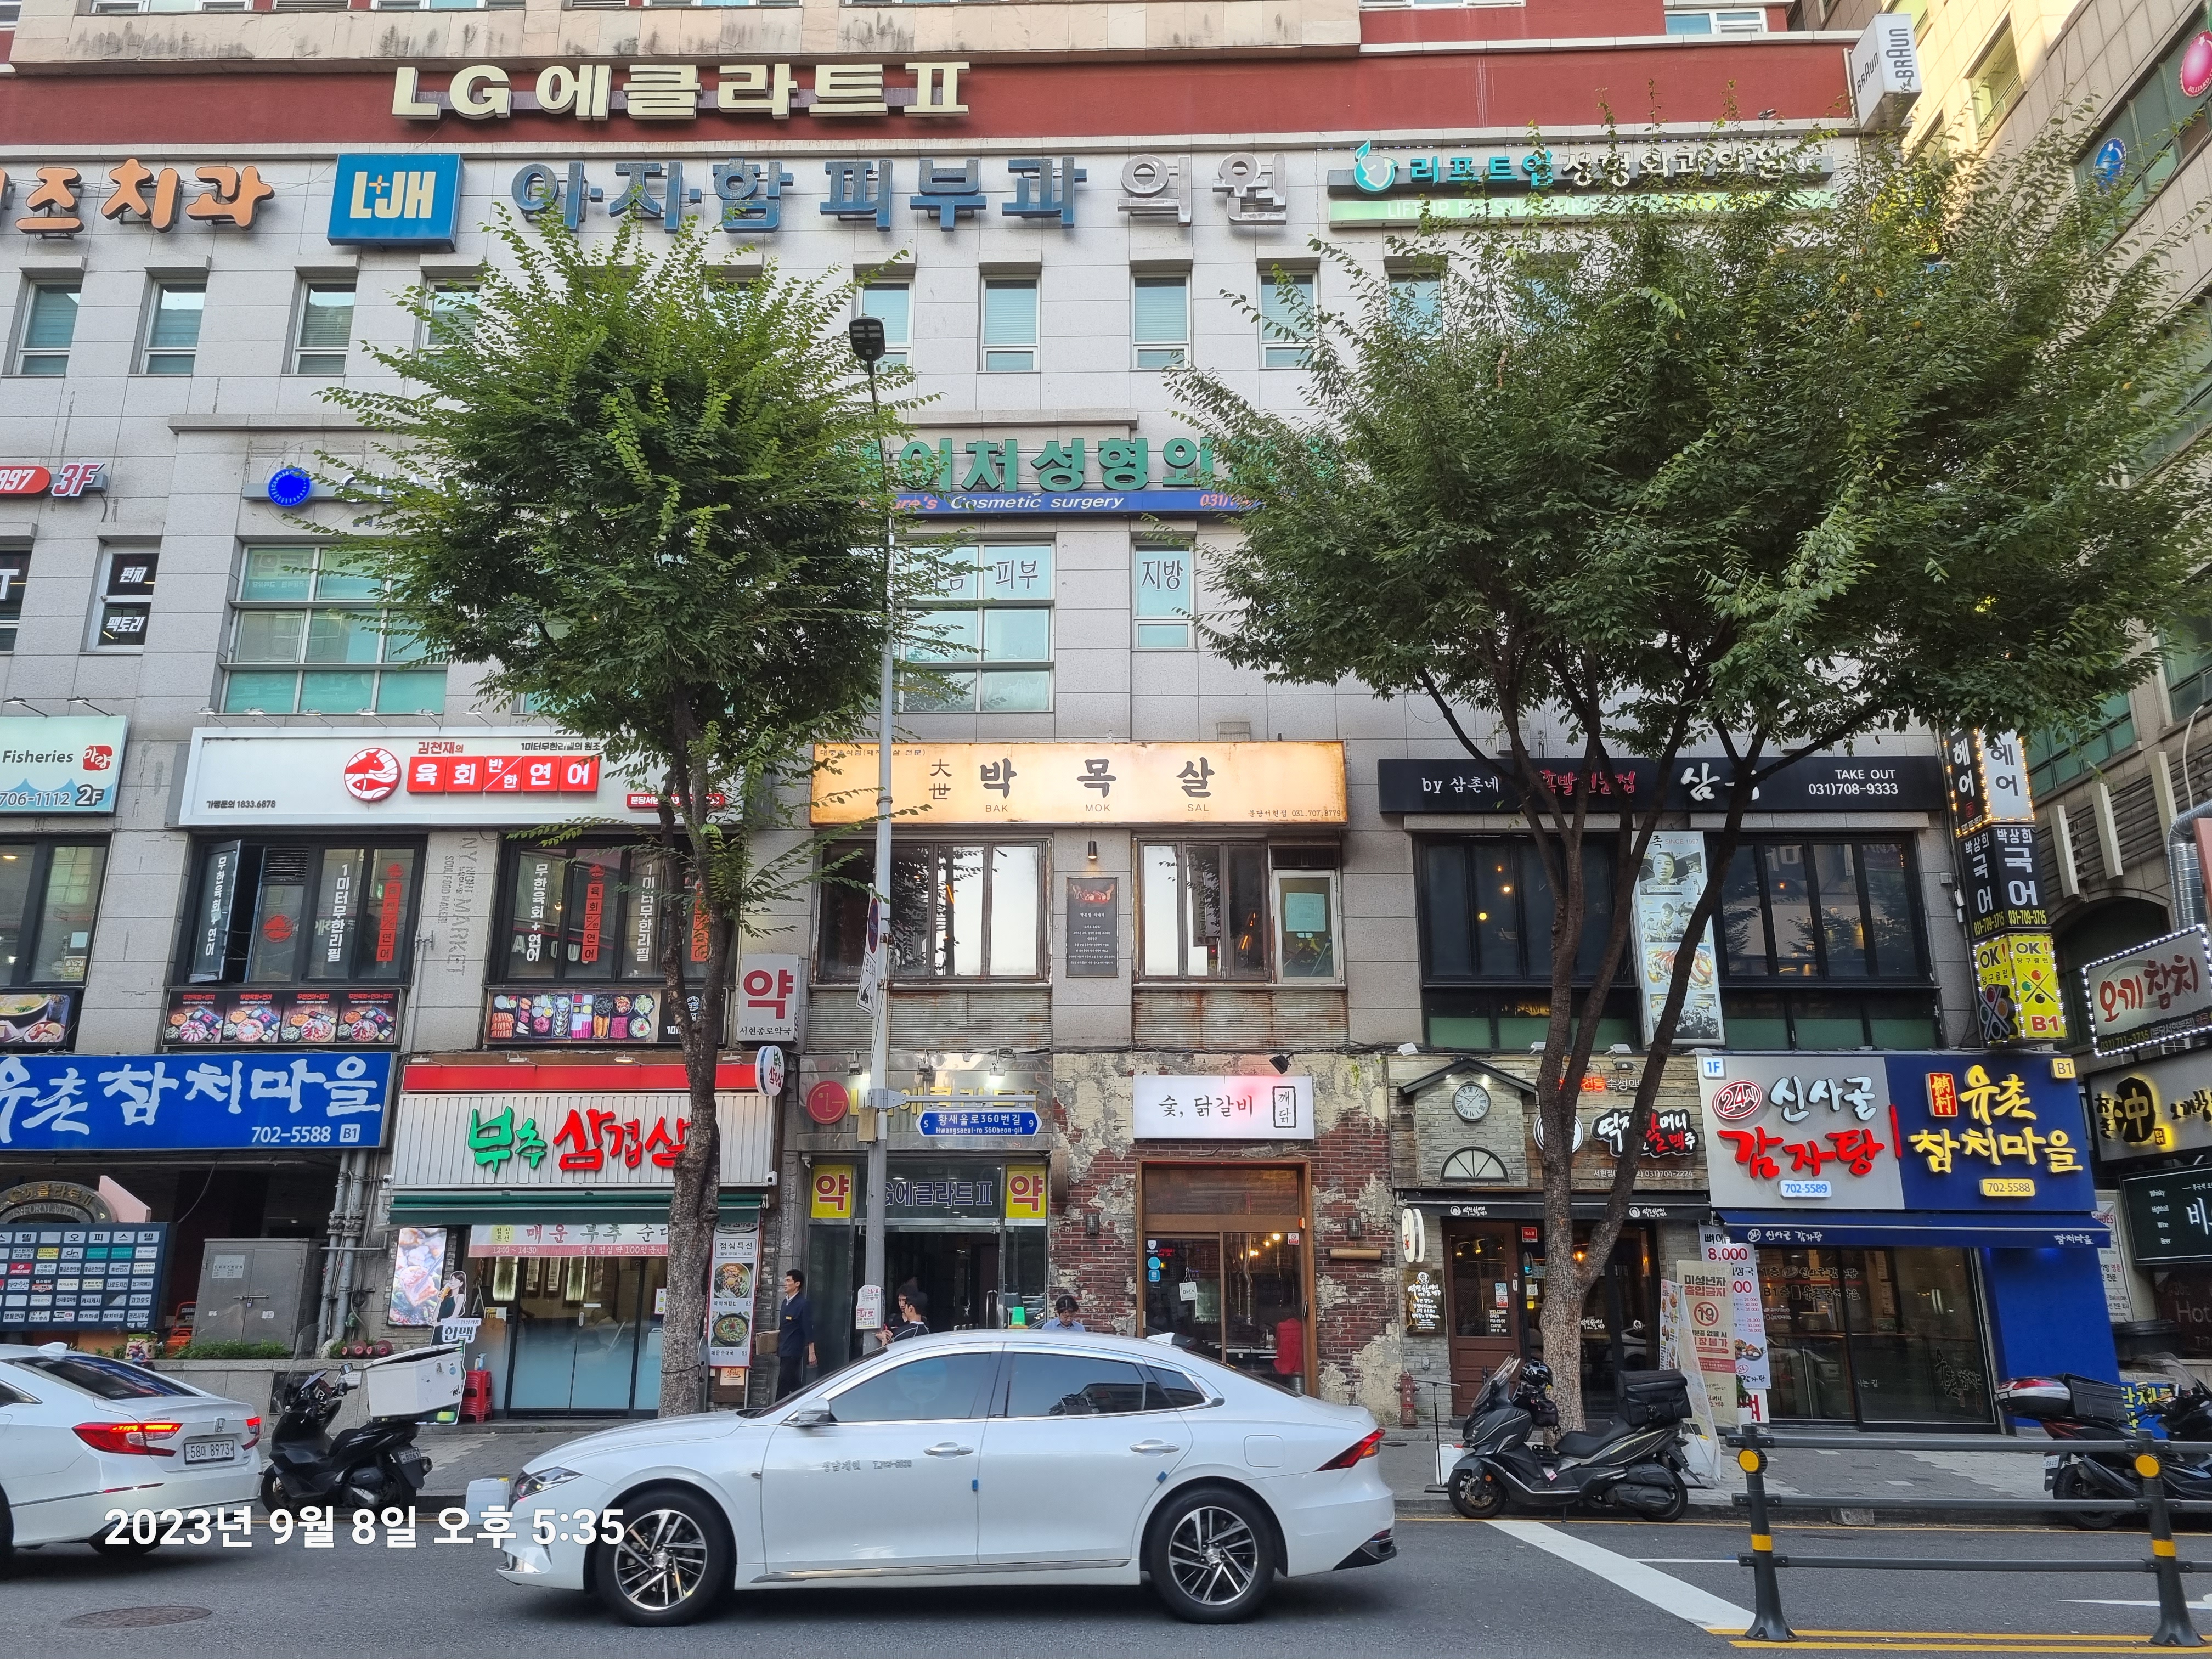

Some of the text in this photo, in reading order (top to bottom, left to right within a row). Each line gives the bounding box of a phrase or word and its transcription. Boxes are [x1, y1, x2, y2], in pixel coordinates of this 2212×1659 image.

[1886, 27, 1915, 79] BRAUN
[1857, 52, 1878, 94] BRAUN
[0, 158, 274, 233] 즈치과
[820, 152, 1287, 233] 피부과 의원
[52, 463, 105, 496] 3F
[951, 495, 1124, 512] Cosmetic surgery
[994, 559, 1039, 591] 피부
[1141, 560, 1184, 591] 지방
[106, 616, 146, 633] 팩토리
[418, 741, 464, 755] 김천재의
[584, 741, 601, 752] 원조
[2, 749, 74, 764] Fisheries
[415, 763, 477, 786] 육회
[529, 763, 589, 786] 연어
[1835, 769, 1896, 780] TAKE OUT
[1422, 776, 1499, 794] by 삼촌네
[1808, 782, 1899, 796] 031)708-9333
[75, 784, 105, 807] 2F
[985, 803, 1210, 813] BAK MOK SAL
[1248, 809, 1341, 818] 분당서현점 031.707.8779
[1965, 831, 1990, 855] 박상희
[1997, 828, 2033, 844] 박상희
[441, 875, 453, 894] FOOD
[1973, 852, 1994, 915] 국어
[2004, 847, 2039, 906] 국어
[328, 863, 350, 962] 1미터무한리필
[526, 864, 549, 962] 무한육회 연어
[2008, 910, 2047, 925] 031-709-3715
[743, 969, 794, 1020] 약
[740, 1026, 792, 1036] 서현종로약국
[2031, 1015, 2059, 1031] B1
[1706, 1061, 1721, 1074] 1F
[2057, 1063, 2073, 1075] B1
[97, 1056, 381, 1126] 참치마을
[1768, 1075, 1878, 1122] 신사골
[1958, 1064, 2038, 1126] 유촌
[1193, 1093, 1254, 1118] 닭갈비
[923, 1113, 1034, 1128] 5 황새울로360번길 9
[251, 1126, 358, 1143] 702-5588 B1
[467, 1105, 693, 1173] 부추 삼겹살
[935, 1126, 1023, 1135] Hwangsaeul-ro 360beon-gil
[1716, 1126, 1886, 1179] 감자탕
[1908, 1127, 2084, 1173] 참치마을
[815, 1173, 850, 1212] 약
[1009, 1174, 1045, 1212] 약
[1784, 1183, 1828, 1194] 702-5589
[1987, 1182, 2031, 1193] 702-5588
[495, 1224, 623, 1244] 점심 매운 부추
[492, 1245, 511, 1254] 12:00
[518, 1245, 537, 1254] 14:30
[599, 1245, 614, 1255] 점심
[719, 1242, 753, 1250] 점심특선
[1707, 1247, 1748, 1261] 8,000
[1684, 1274, 1726, 1287] 미성년자
[1684, 1285, 1726, 1297] 출입금지
[1698, 1307, 1715, 1321] 19
[444, 1325, 475, 1341] 한맥
[1694, 1337, 1728, 1348] 장불가
[210, 1444, 230, 1457] 8973
